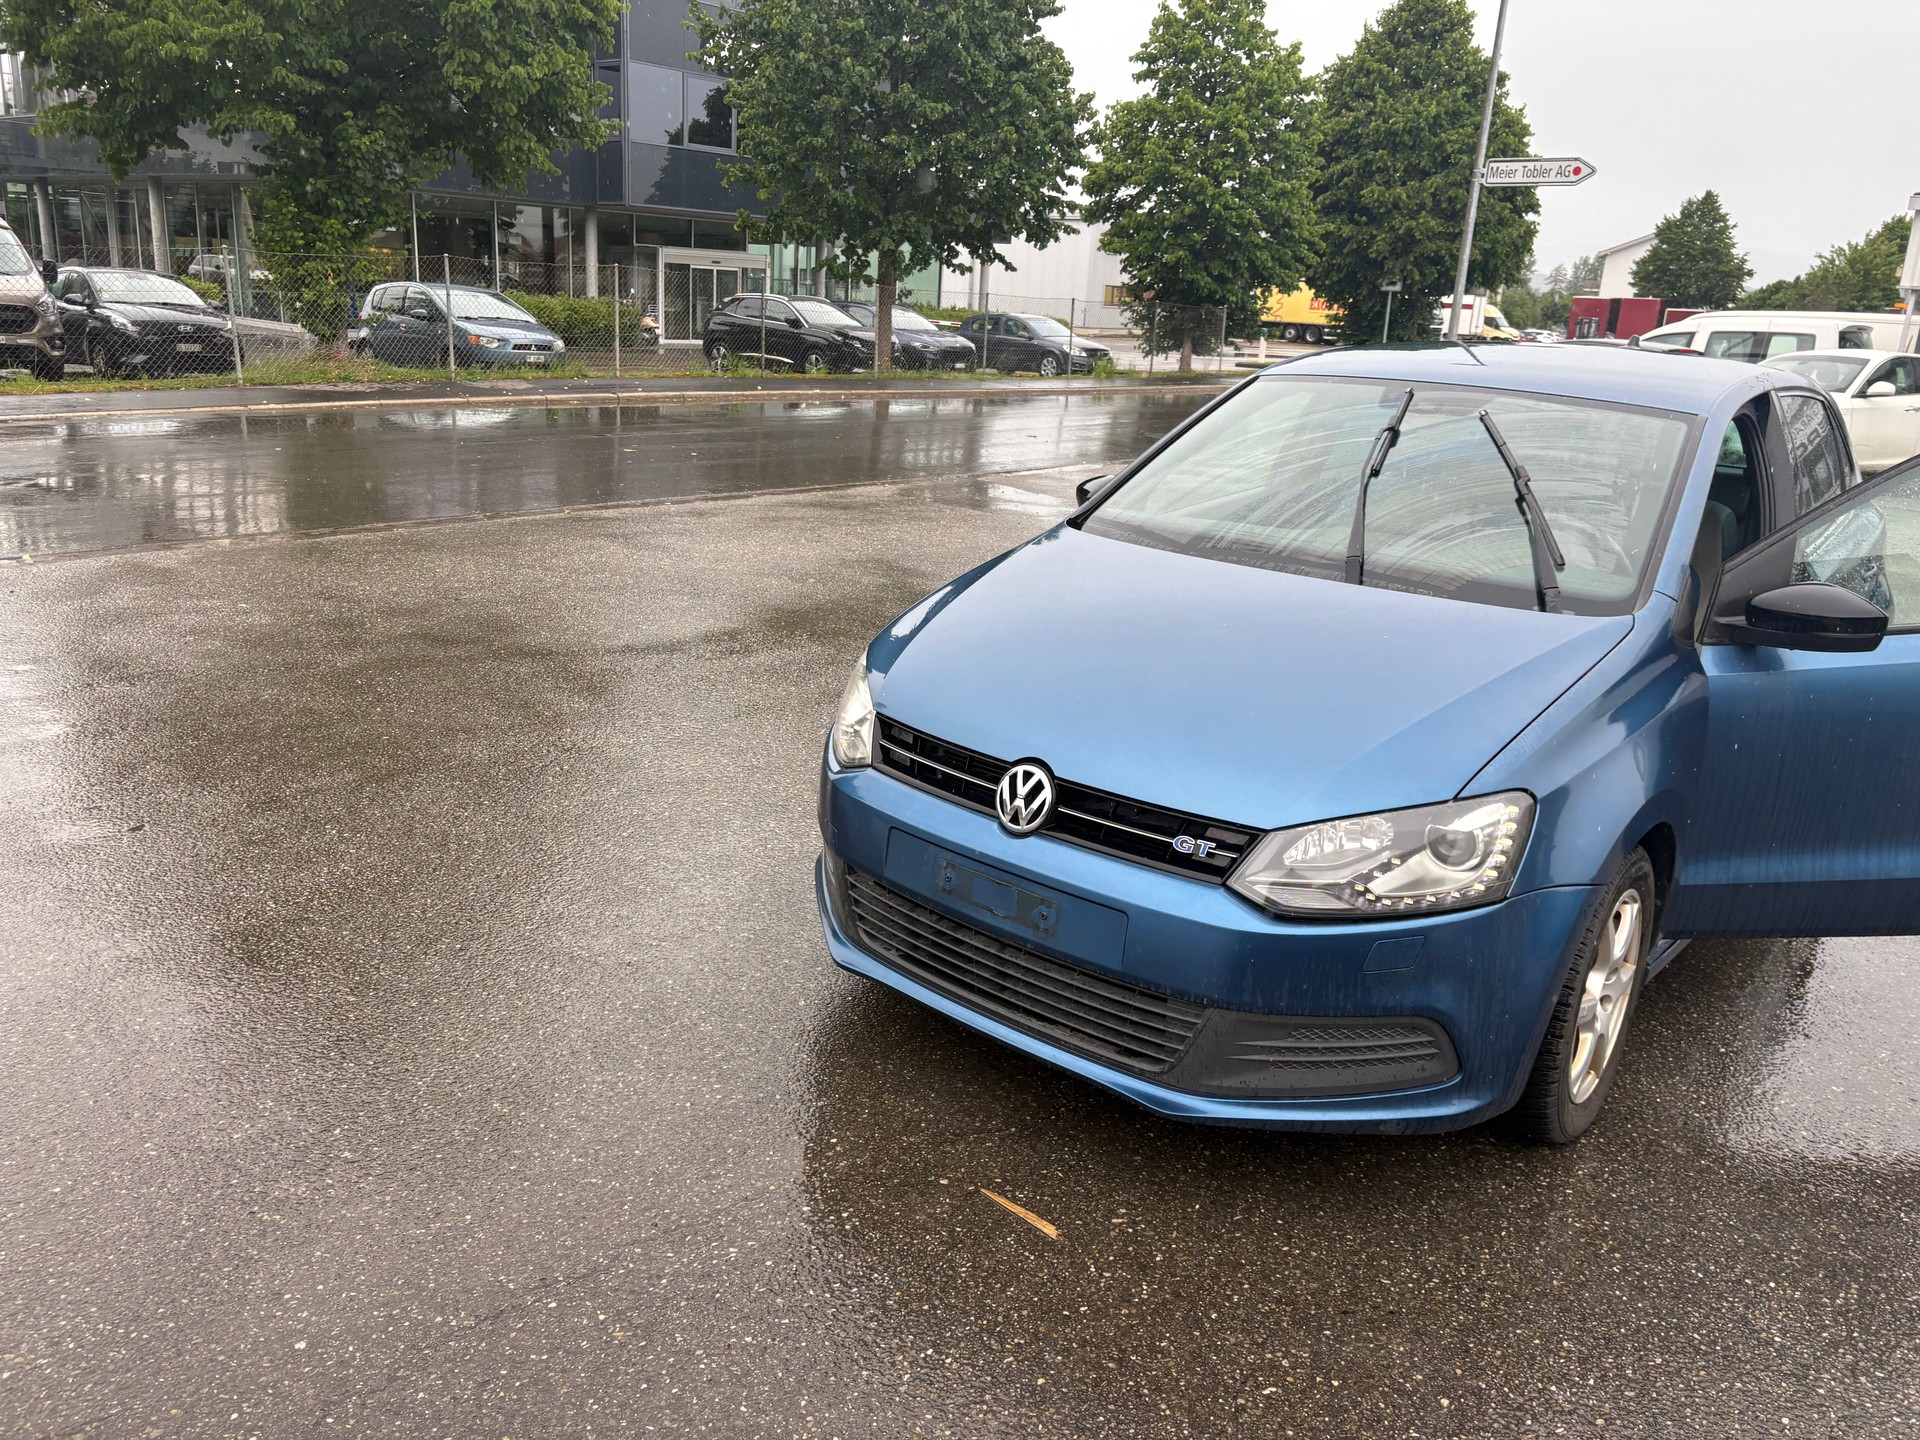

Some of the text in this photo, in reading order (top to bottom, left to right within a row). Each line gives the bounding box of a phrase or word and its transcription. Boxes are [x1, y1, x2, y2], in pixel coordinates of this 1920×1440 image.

[1489, 164, 1572, 179] Meier Tobler AG
[996, 765, 1053, 832] VW
[1173, 835, 1216, 857] GT
